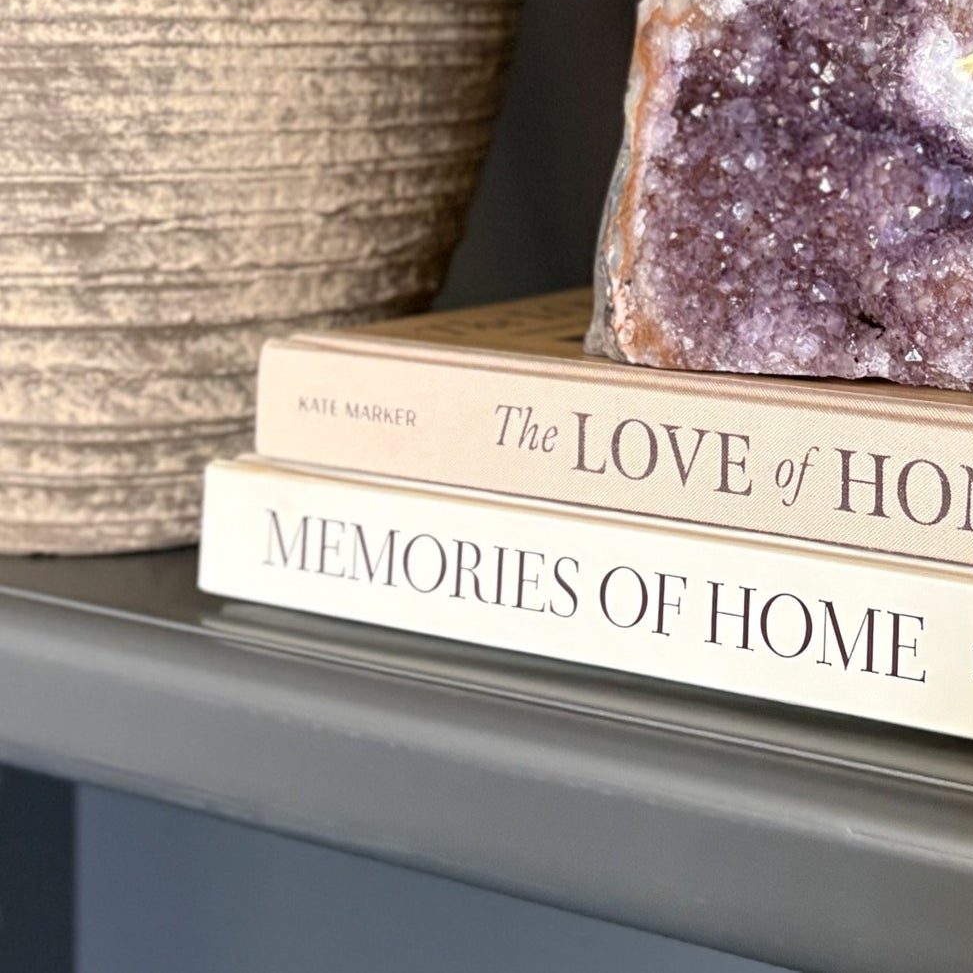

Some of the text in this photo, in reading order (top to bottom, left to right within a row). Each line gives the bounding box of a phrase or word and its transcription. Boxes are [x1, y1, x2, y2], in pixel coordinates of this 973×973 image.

[298, 396, 417, 427] KATE MARKER
[494, 404, 559, 453] The
[571, 412, 754, 497] LOVE
[774, 446, 820, 506] of
[262, 509, 580, 618] MEMORIES
[599, 566, 688, 636] OF
[704, 581, 927, 684] HOME
